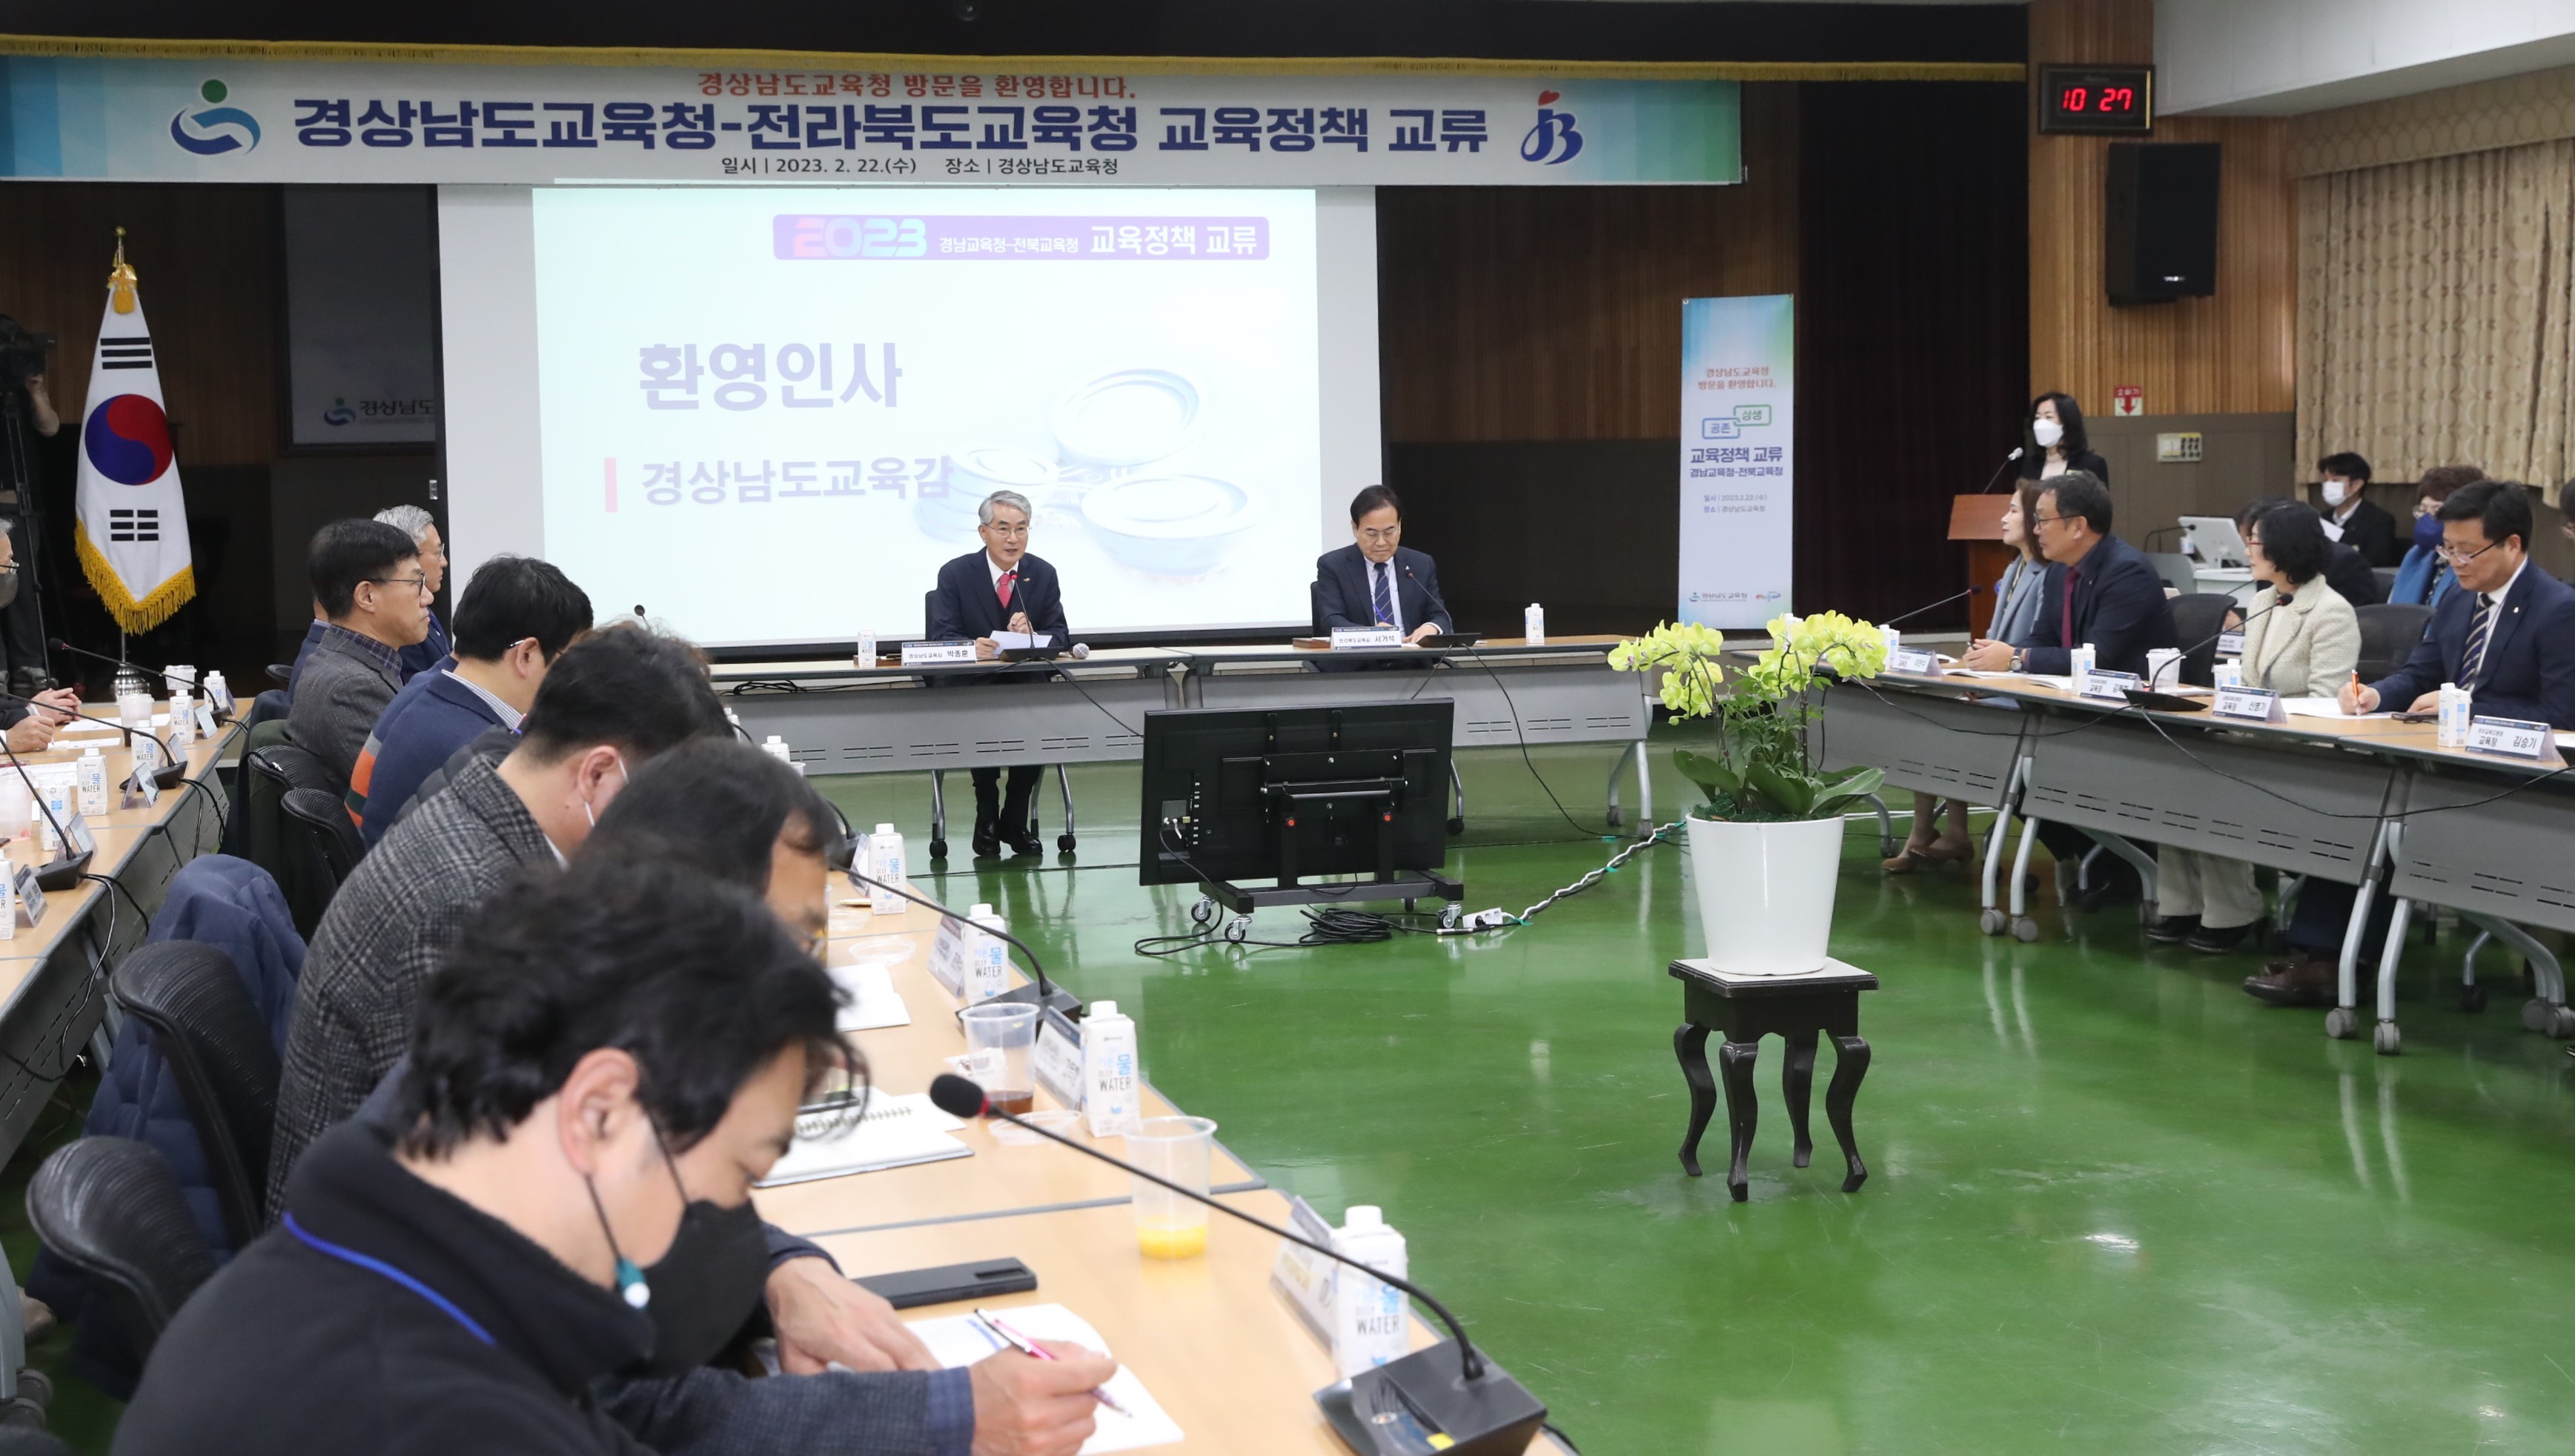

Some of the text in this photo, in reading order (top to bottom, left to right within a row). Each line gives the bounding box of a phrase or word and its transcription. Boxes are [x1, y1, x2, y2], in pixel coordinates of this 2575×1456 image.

[698, 73, 1136, 99] 경상남도교육청 방문을 환영합니다.
[2063, 87, 2132, 111] 10 27
[294, 99, 1488, 153] 경상남도교육청-전라북도교육청 교육정책 교류
[722, 158, 756, 175] 일시
[776, 159, 828, 174] 2023.
[835, 159, 850, 174] 2.
[857, 157, 916, 176] 22.(수)
[945, 158, 980, 175] 장소
[998, 158, 1119, 176] 경상남도교육청
[794, 218, 927, 257] 2023
[939, 225, 1257, 256] 경남교육청-전북교육청 교육정책 교류
[639, 342, 903, 410] 환영인사
[1743, 410, 1763, 421] 상생
[1711, 423, 1731, 433] 공존
[1691, 447, 1783, 463] 교육정책 교류
[642, 455, 953, 505] 경상남도교육감
[1690, 467, 1783, 478] 경남교육청-전북교육청
[2513, 736, 2537, 749] 김승기
[82, 785, 101, 794] WATER
[877, 874, 899, 884] WATER
[990, 947, 1002, 965] 물
[975, 965, 1002, 978] WATER
[1117, 1054, 1132, 1076] 물
[1098, 1077, 1132, 1093] WATER
[1356, 1315, 1400, 1337] WATER
